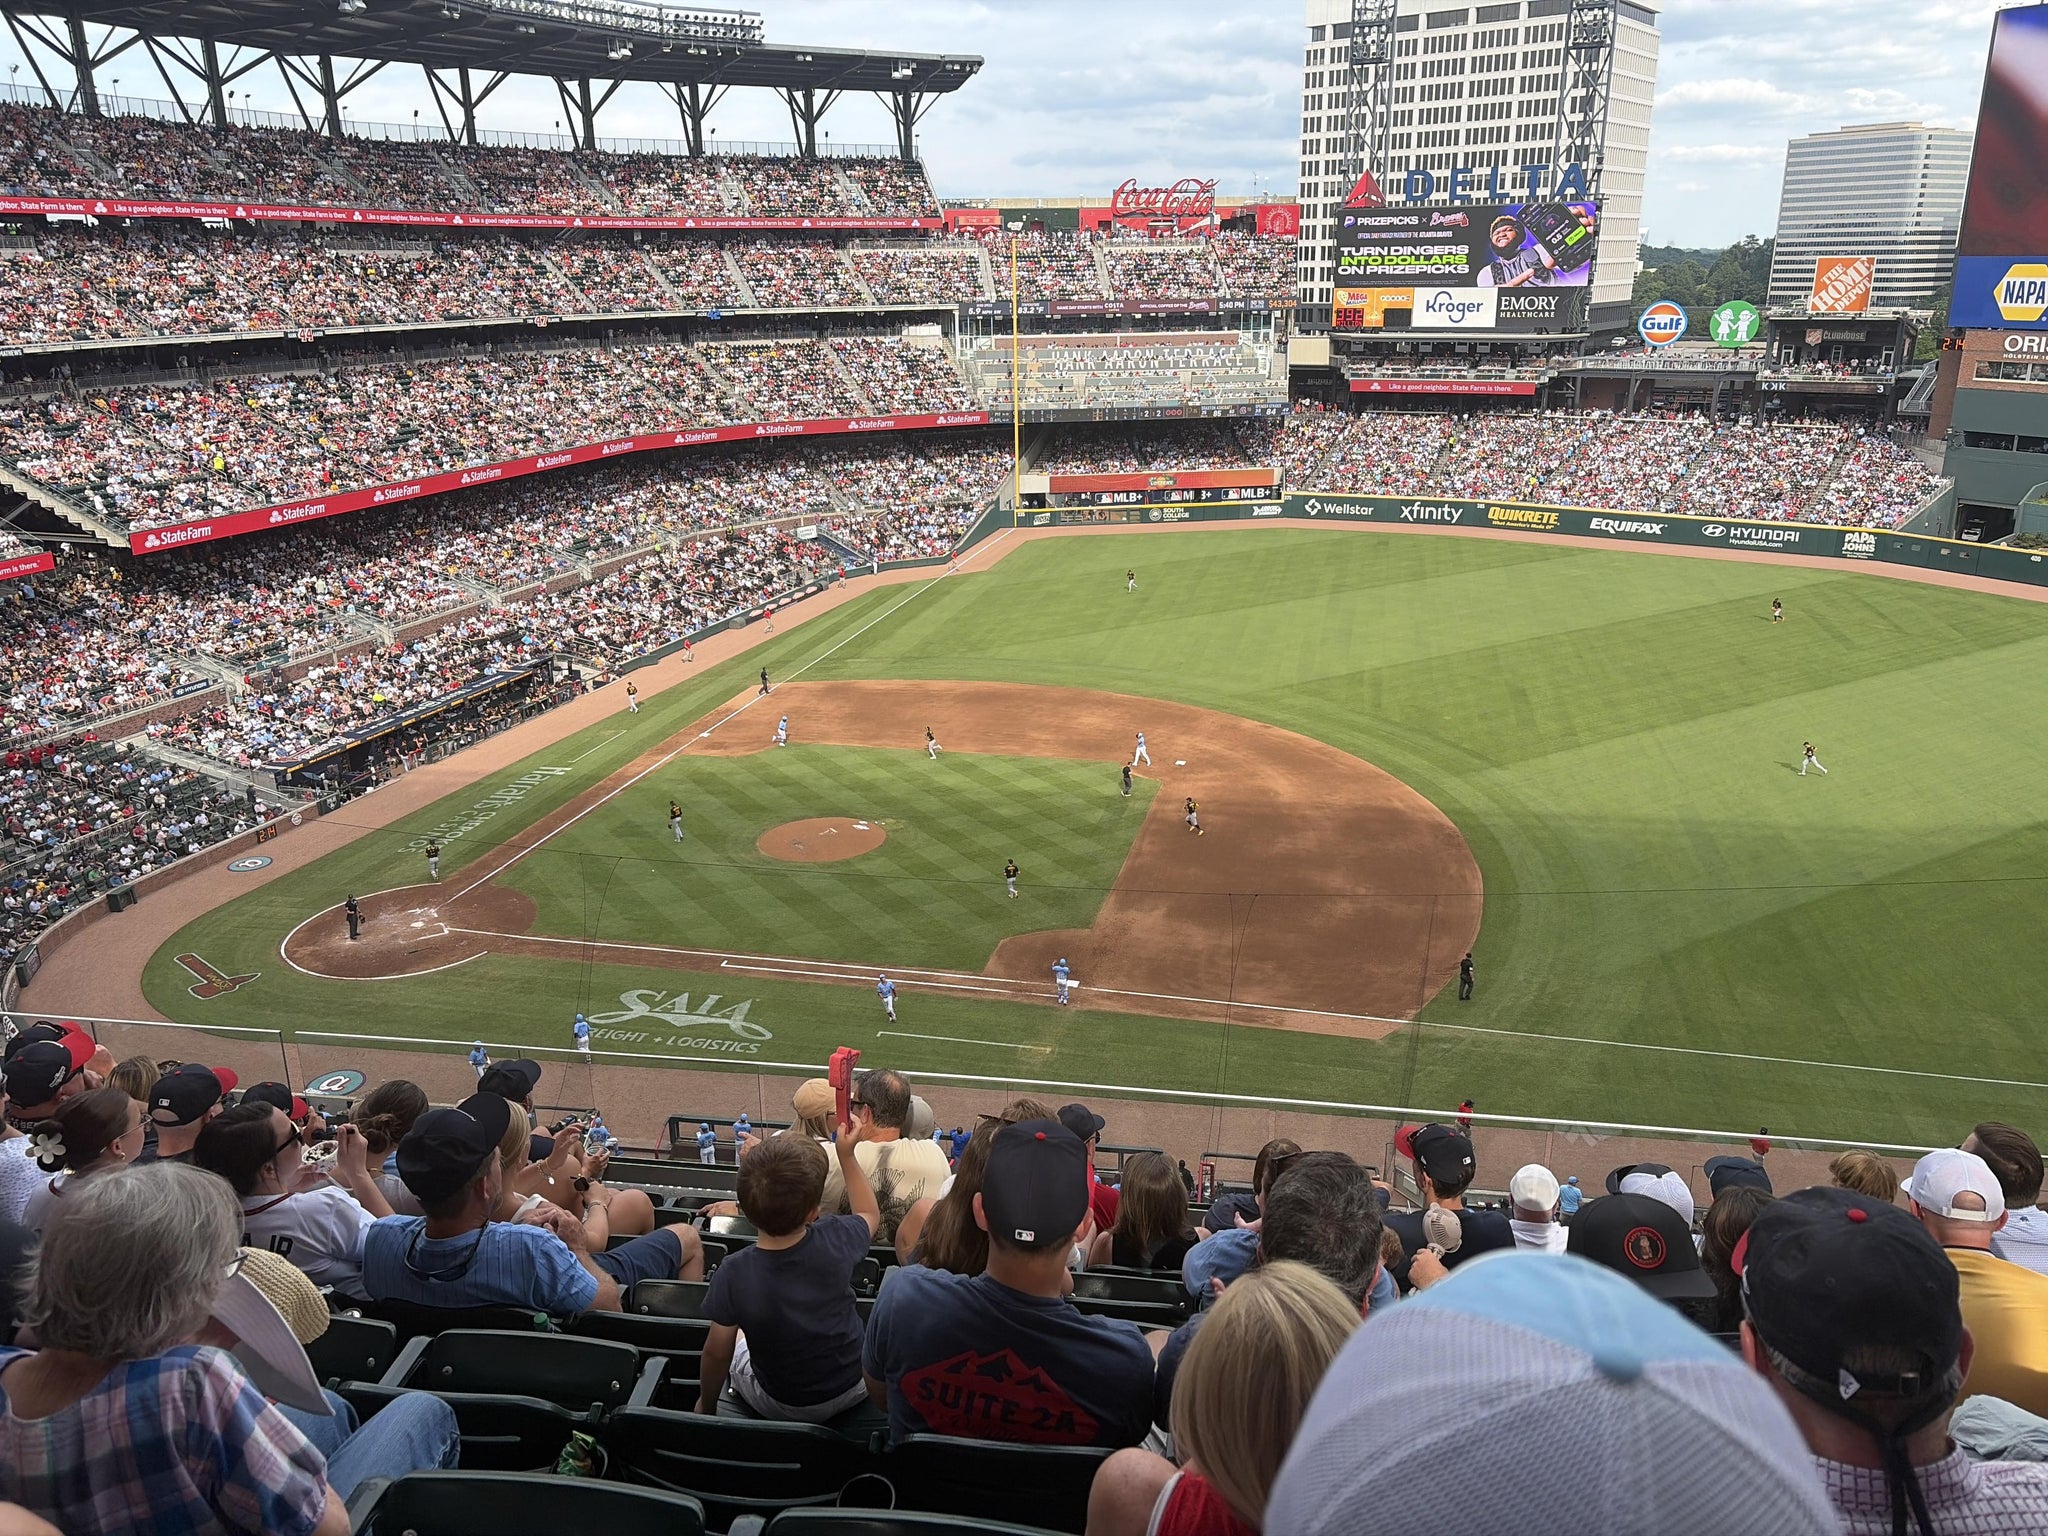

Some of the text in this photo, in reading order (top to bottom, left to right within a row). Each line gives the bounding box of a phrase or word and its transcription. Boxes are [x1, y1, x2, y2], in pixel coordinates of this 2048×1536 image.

[1405, 163, 1588, 202] DELTA
[20, 202, 40, 210] State
[114, 204, 126, 212] Like
[148, 206, 174, 215] neighbor,
[191, 206, 206, 214] Farm
[280, 210, 302, 218] neighbor,
[303, 210, 316, 218] State
[1357, 216, 1419, 226] PRIZEPICKS
[1340, 245, 1470, 257] TURN DINGERS
[1341, 255, 1467, 266] INTO DOLLARS
[1337, 264, 1470, 275] ON PRIZEPICKS
[1820, 263, 1846, 286] THE
[1812, 257, 1874, 311] HOME
[1833, 277, 1872, 311] DEPOT
[2003, 280, 2046, 304] NAPA
[1219, 301, 1233, 309] 5:40
[1234, 301, 1245, 309] PM
[1426, 290, 1484, 323] Kroger
[1500, 296, 1559, 311] EMORY
[1336, 308, 1363, 321] 392
[1641, 317, 1683, 331] Gulf
[297, 328, 314, 343] 44
[1822, 330, 1865, 340] CLUBHOUSE
[2004, 335, 2048, 353] ORI
[1423, 384, 1451, 392] neighbor,
[1113, 492, 1143, 503] MLB+
[1240, 488, 1271, 499] MLB+
[1324, 502, 1375, 515] Wellstar
[1399, 504, 1464, 524] xfinity
[1488, 506, 1560, 525] QUIKRETE
[1589, 517, 1665, 535] EQUIFAX
[1729, 527, 1800, 542] HYUNDAI
[1844, 531, 1876, 544] PAPA
[1729, 538, 1783, 548] HyundaiUSA.com
[1841, 542, 1876, 553] JOHNS
[12, 565, 18, 573] is
[586, 989, 773, 1040] SAIA
[665, 1036, 762, 1054] LOGISTICS
[917, 1376, 1021, 1425] SUITE
[1031, 1406, 1077, 1434] 2A
